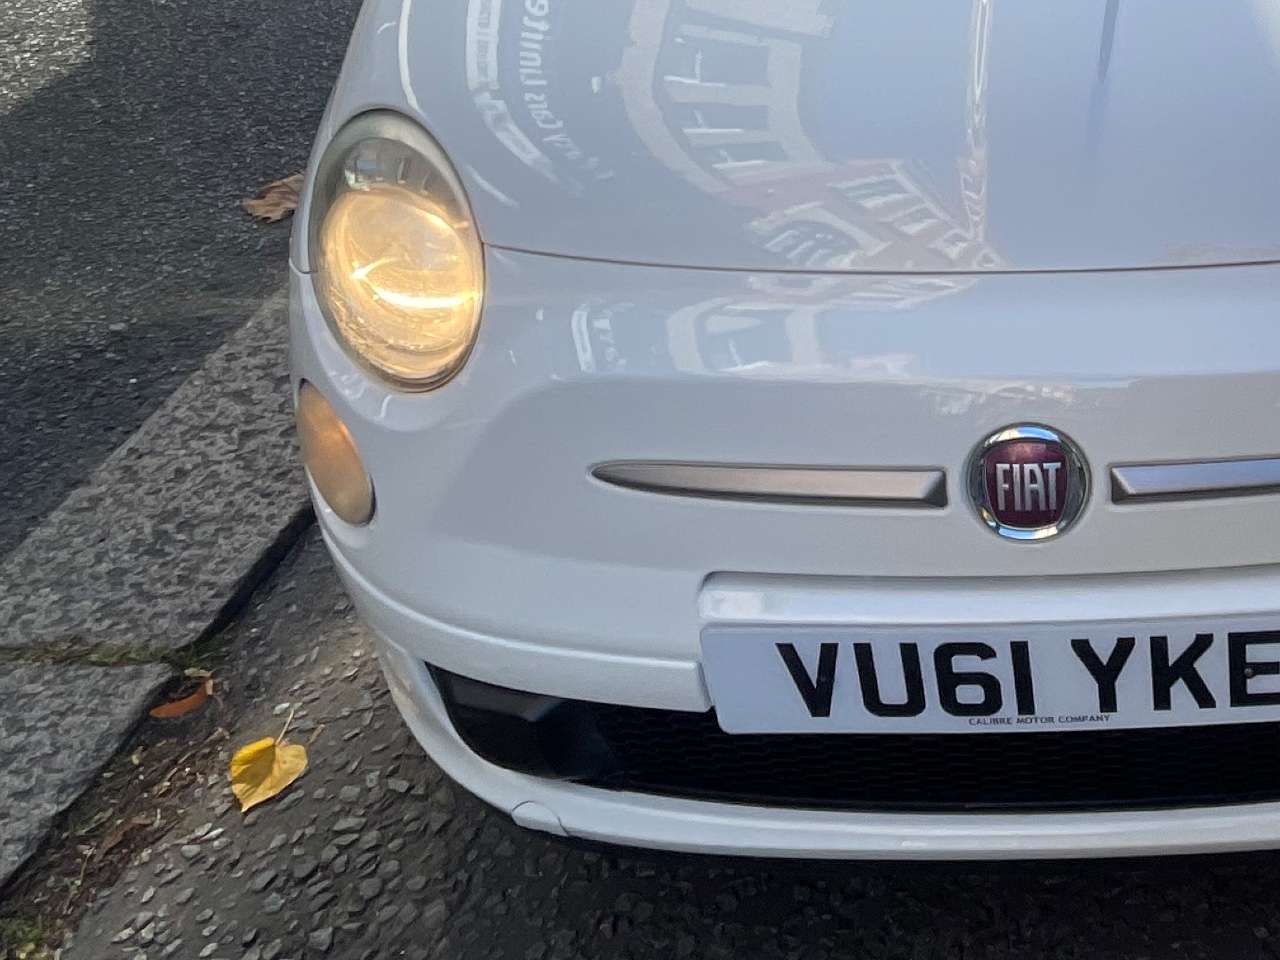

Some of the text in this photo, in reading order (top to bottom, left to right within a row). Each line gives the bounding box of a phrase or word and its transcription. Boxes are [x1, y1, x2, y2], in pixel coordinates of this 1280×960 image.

[995, 462, 1061, 511] FIAT
[776, 641, 1033, 718] VU61
[968, 714, 1111, 726] CALIBRE MOTOR COMPANY
